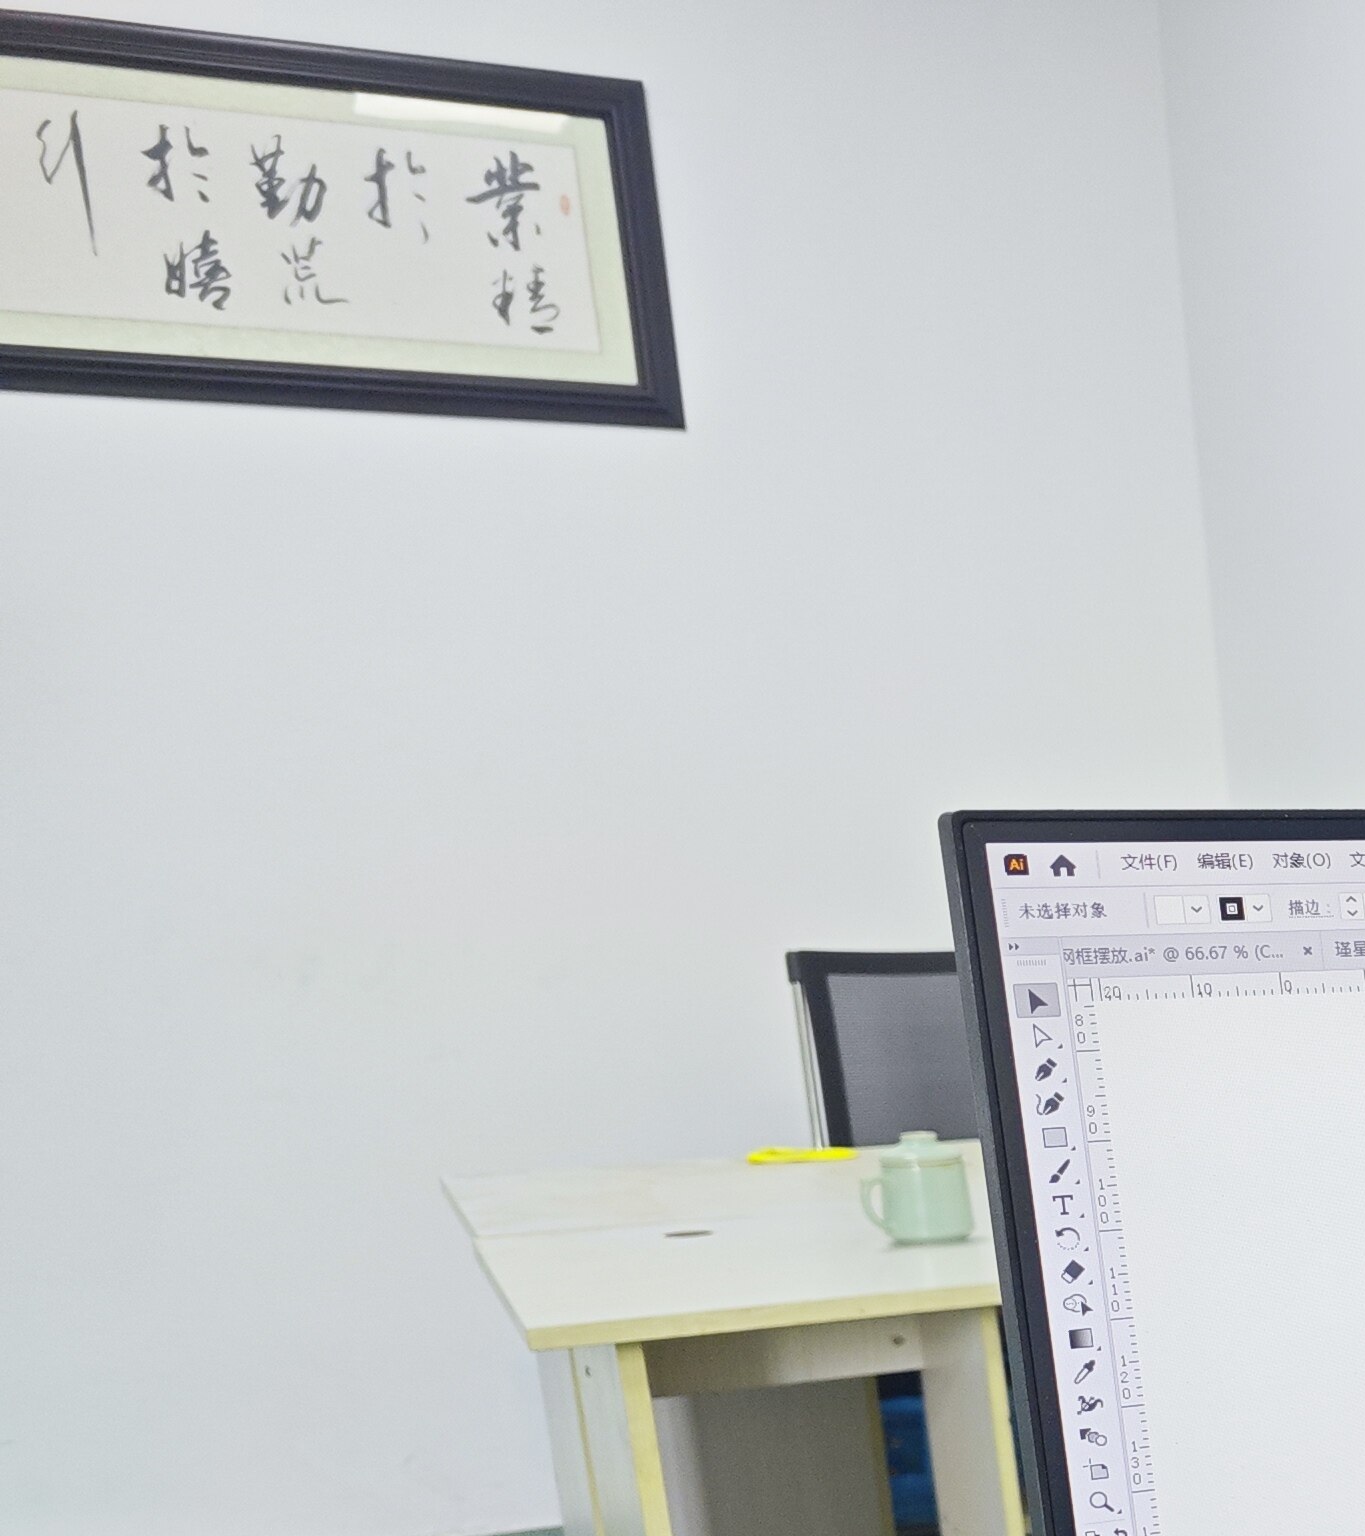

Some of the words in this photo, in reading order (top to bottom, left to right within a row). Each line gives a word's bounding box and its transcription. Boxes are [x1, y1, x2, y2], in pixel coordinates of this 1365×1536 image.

[1009, 858, 1024, 871] Ai
[1121, 853, 1178, 872] 文件(F)
[1197, 852, 1254, 870] 编辑(E)
[1272, 851, 1331, 870] 对象(O)
[1019, 902, 1108, 920] 未选择对象
[1185, 946, 1228, 961] 66.67
